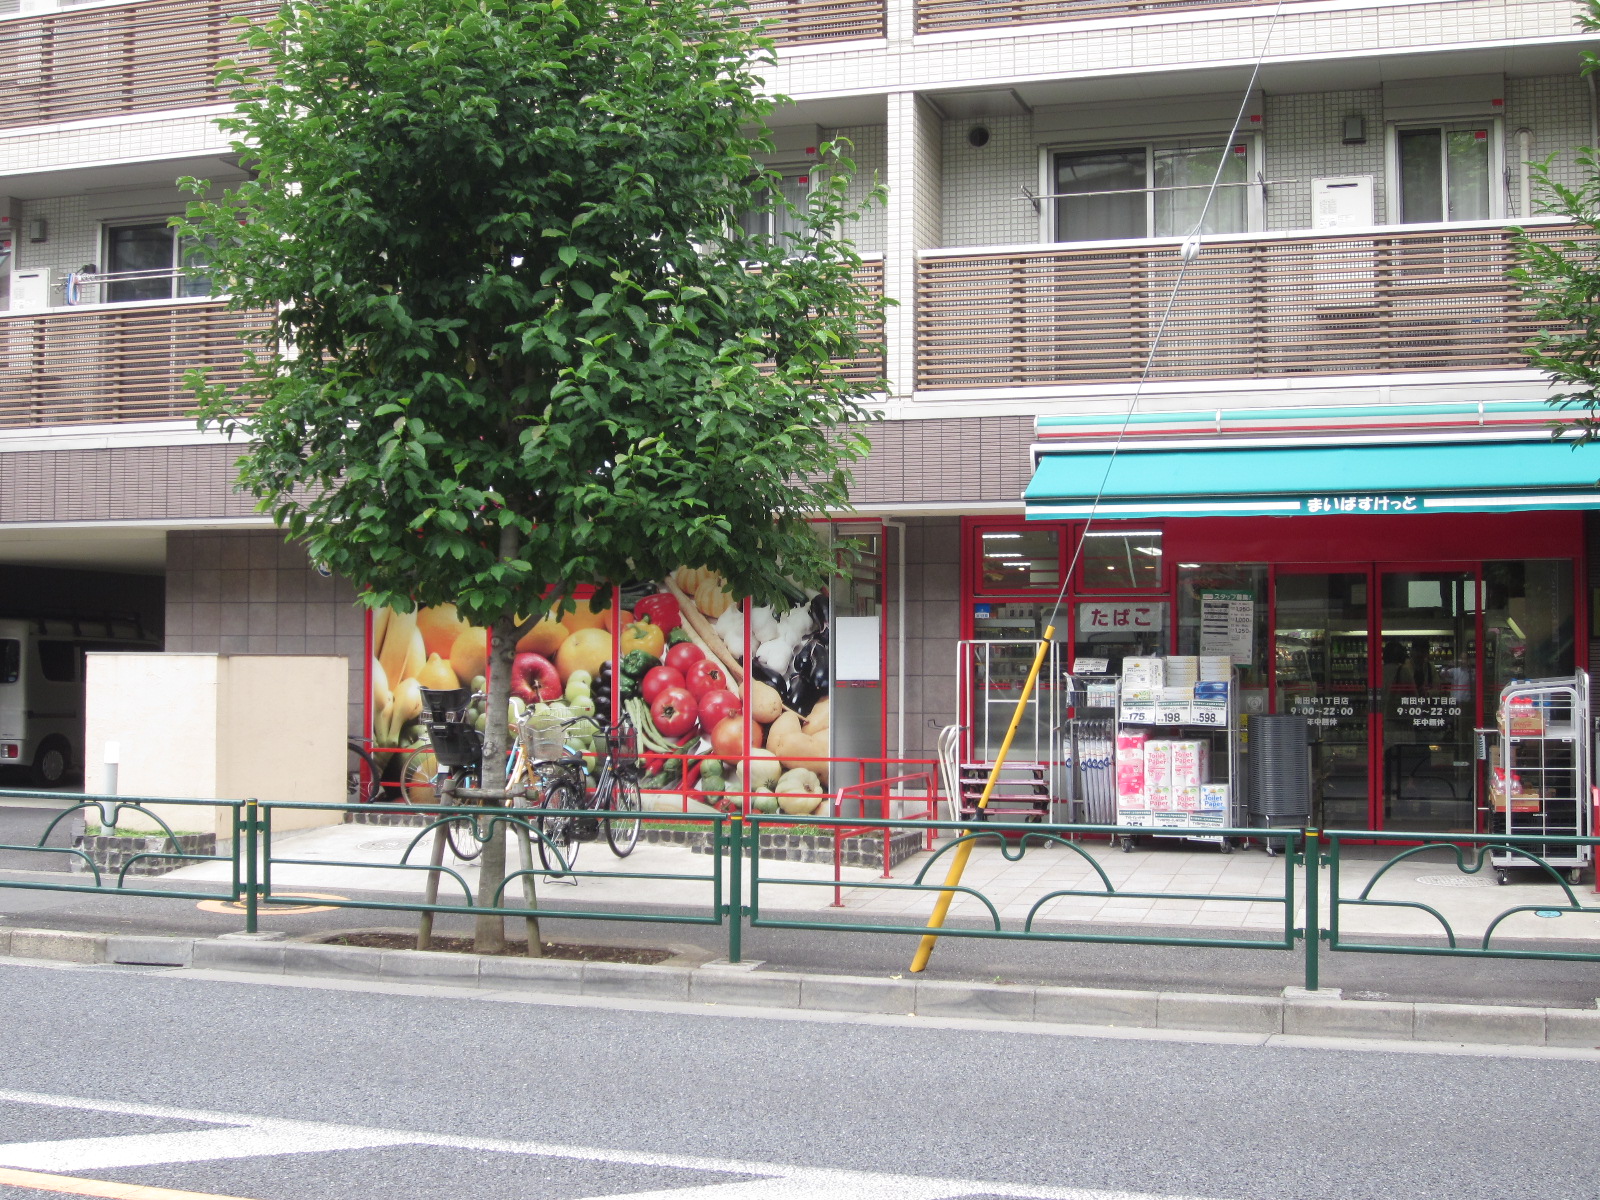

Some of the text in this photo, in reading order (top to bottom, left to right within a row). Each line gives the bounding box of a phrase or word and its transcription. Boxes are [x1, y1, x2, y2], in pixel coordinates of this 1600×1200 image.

[1307, 496, 1417, 512] まいばすけっと
[1091, 608, 1151, 626] たばこ
[1164, 713, 1180, 722] 198
[1199, 713, 1216, 723] 598
[1204, 793, 1222, 801] Toilet
